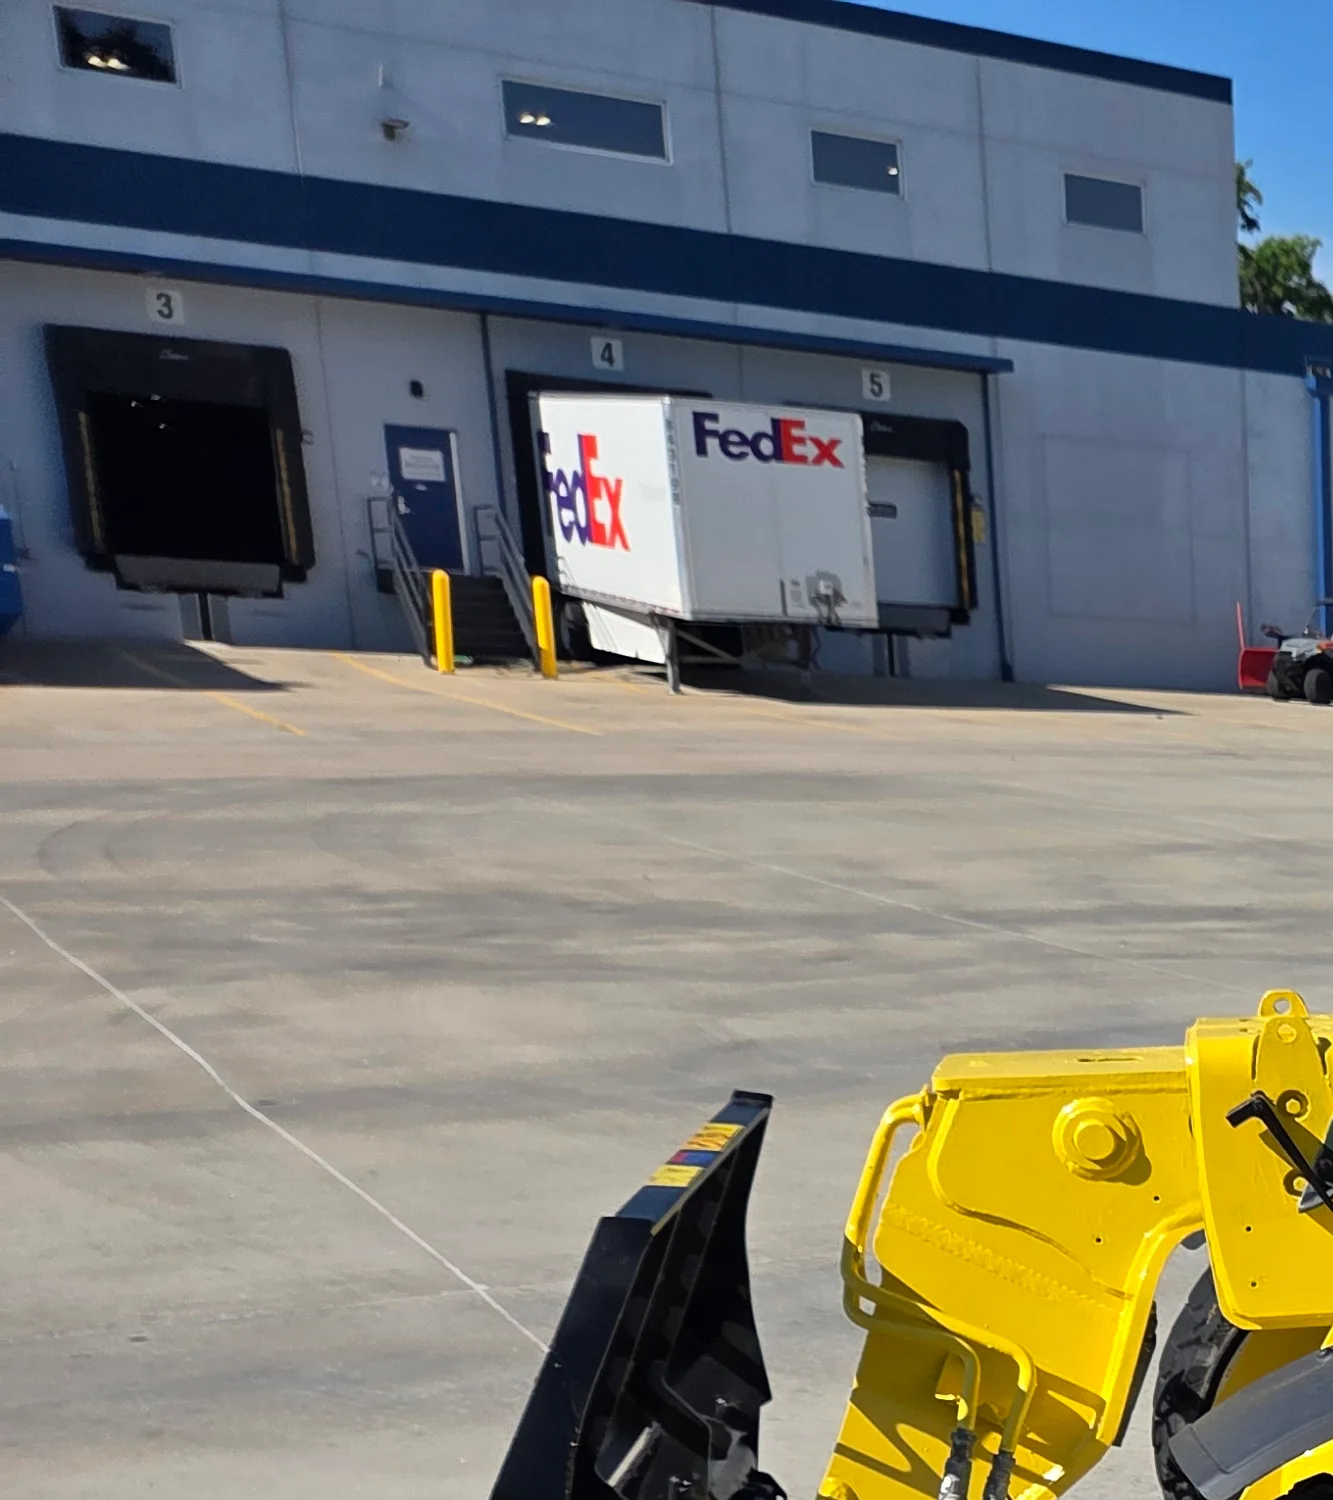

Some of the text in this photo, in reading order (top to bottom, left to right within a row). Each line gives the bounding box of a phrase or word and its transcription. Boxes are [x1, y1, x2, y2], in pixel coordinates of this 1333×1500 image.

[156, 292, 174, 319] 3
[598, 340, 615, 368] 4
[869, 372, 884, 398] 5
[693, 411, 845, 468] FedEx
